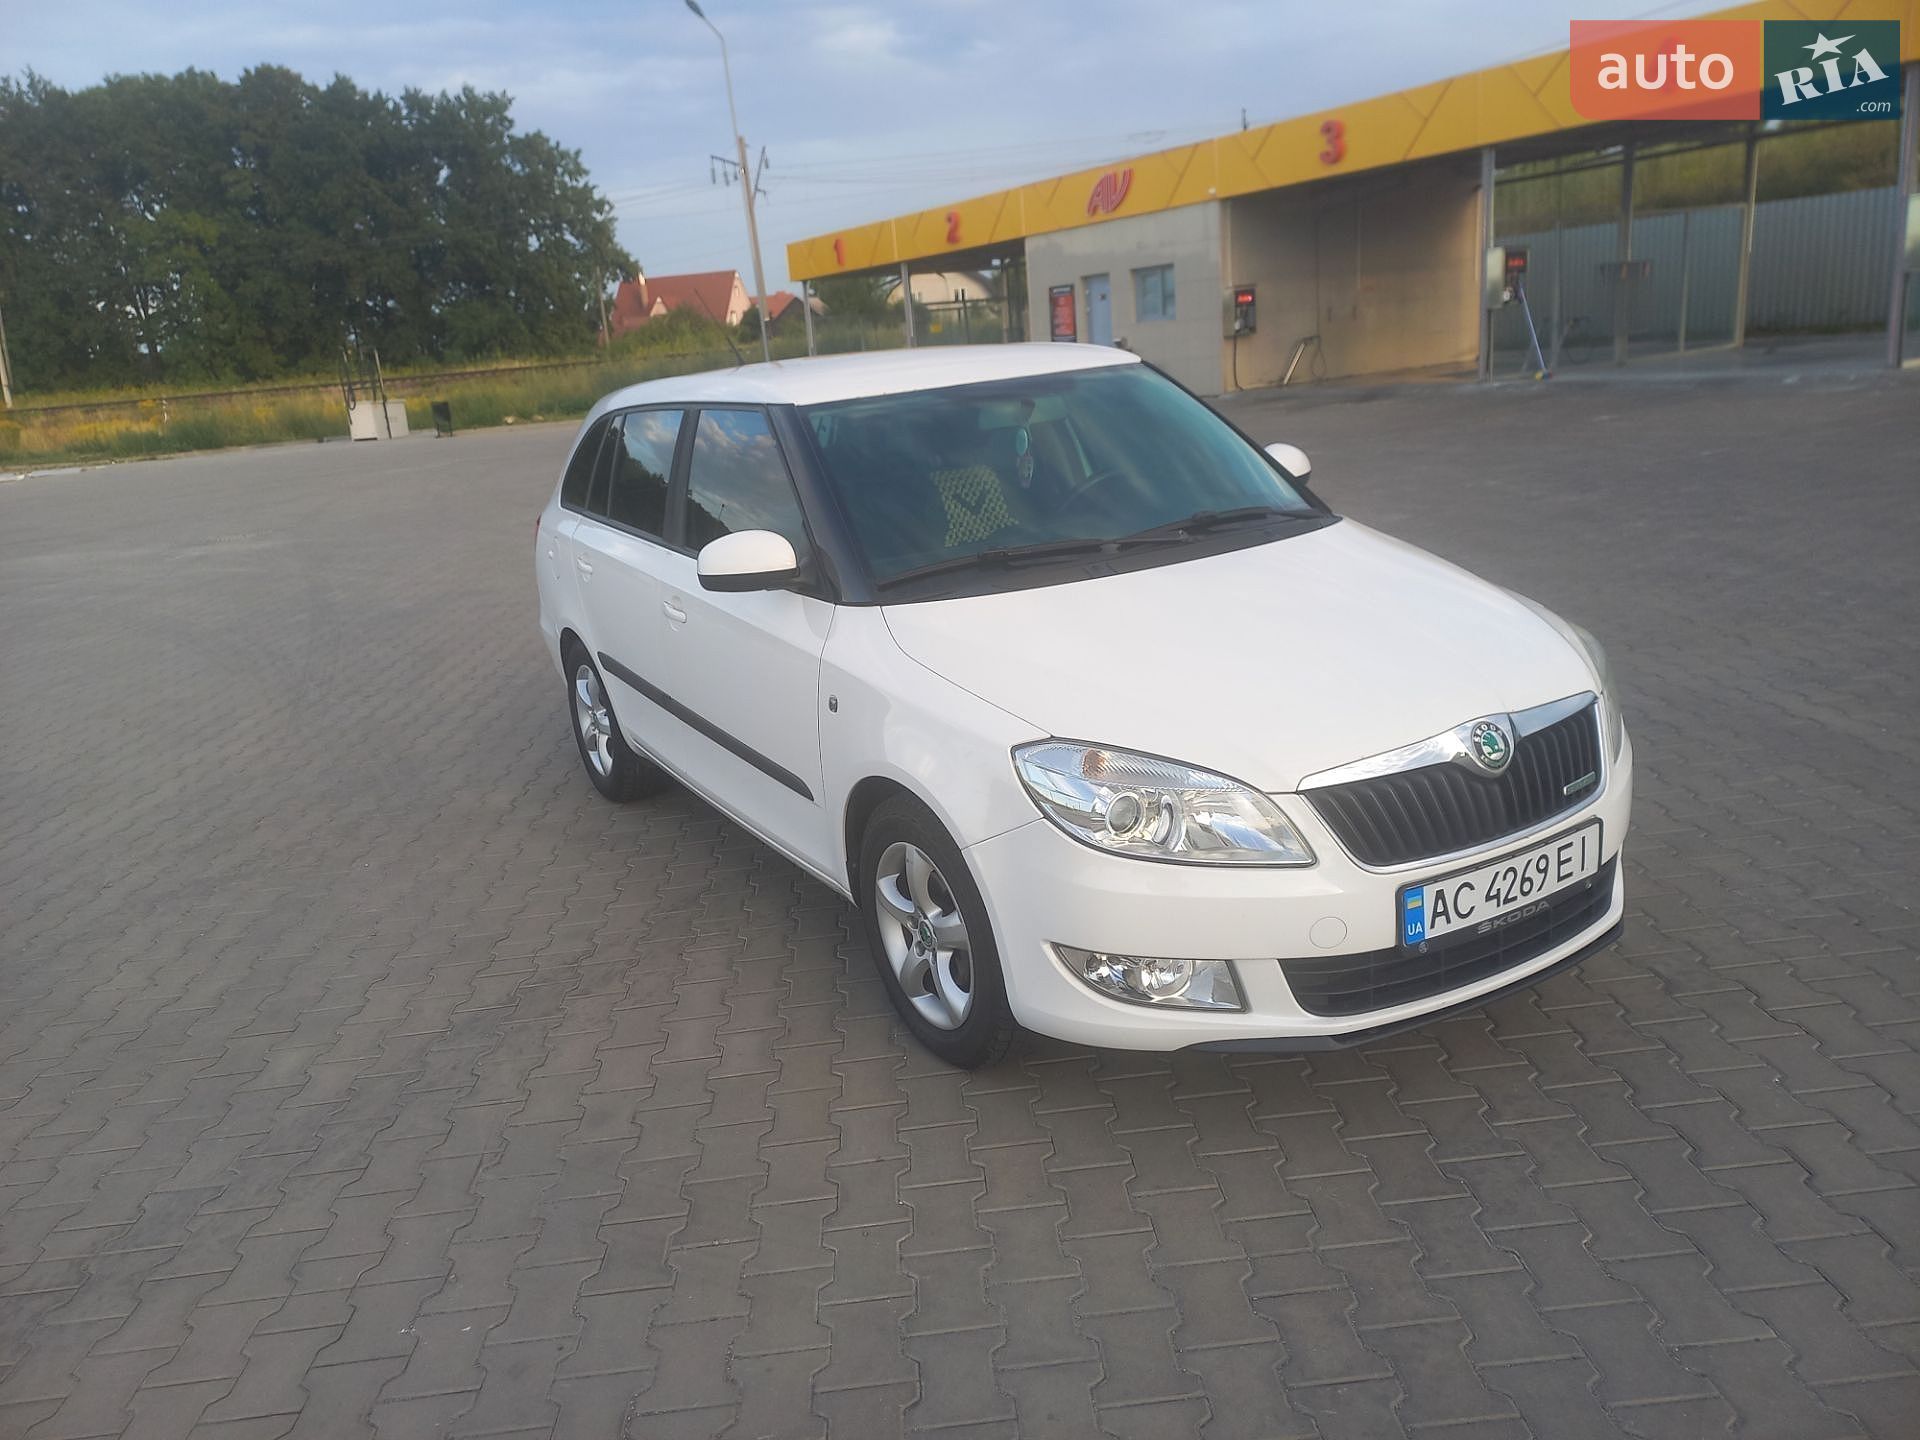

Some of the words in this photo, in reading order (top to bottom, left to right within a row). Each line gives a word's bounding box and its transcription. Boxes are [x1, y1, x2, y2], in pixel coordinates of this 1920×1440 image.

[1319, 119, 1346, 165] 3
[945, 210, 961, 245] 2
[832, 238, 845, 267] 1
[1430, 881, 1476, 930] AC
[1484, 853, 1549, 909] 4269
[1556, 836, 1586, 884] EI
[1407, 922, 1424, 937] UA
